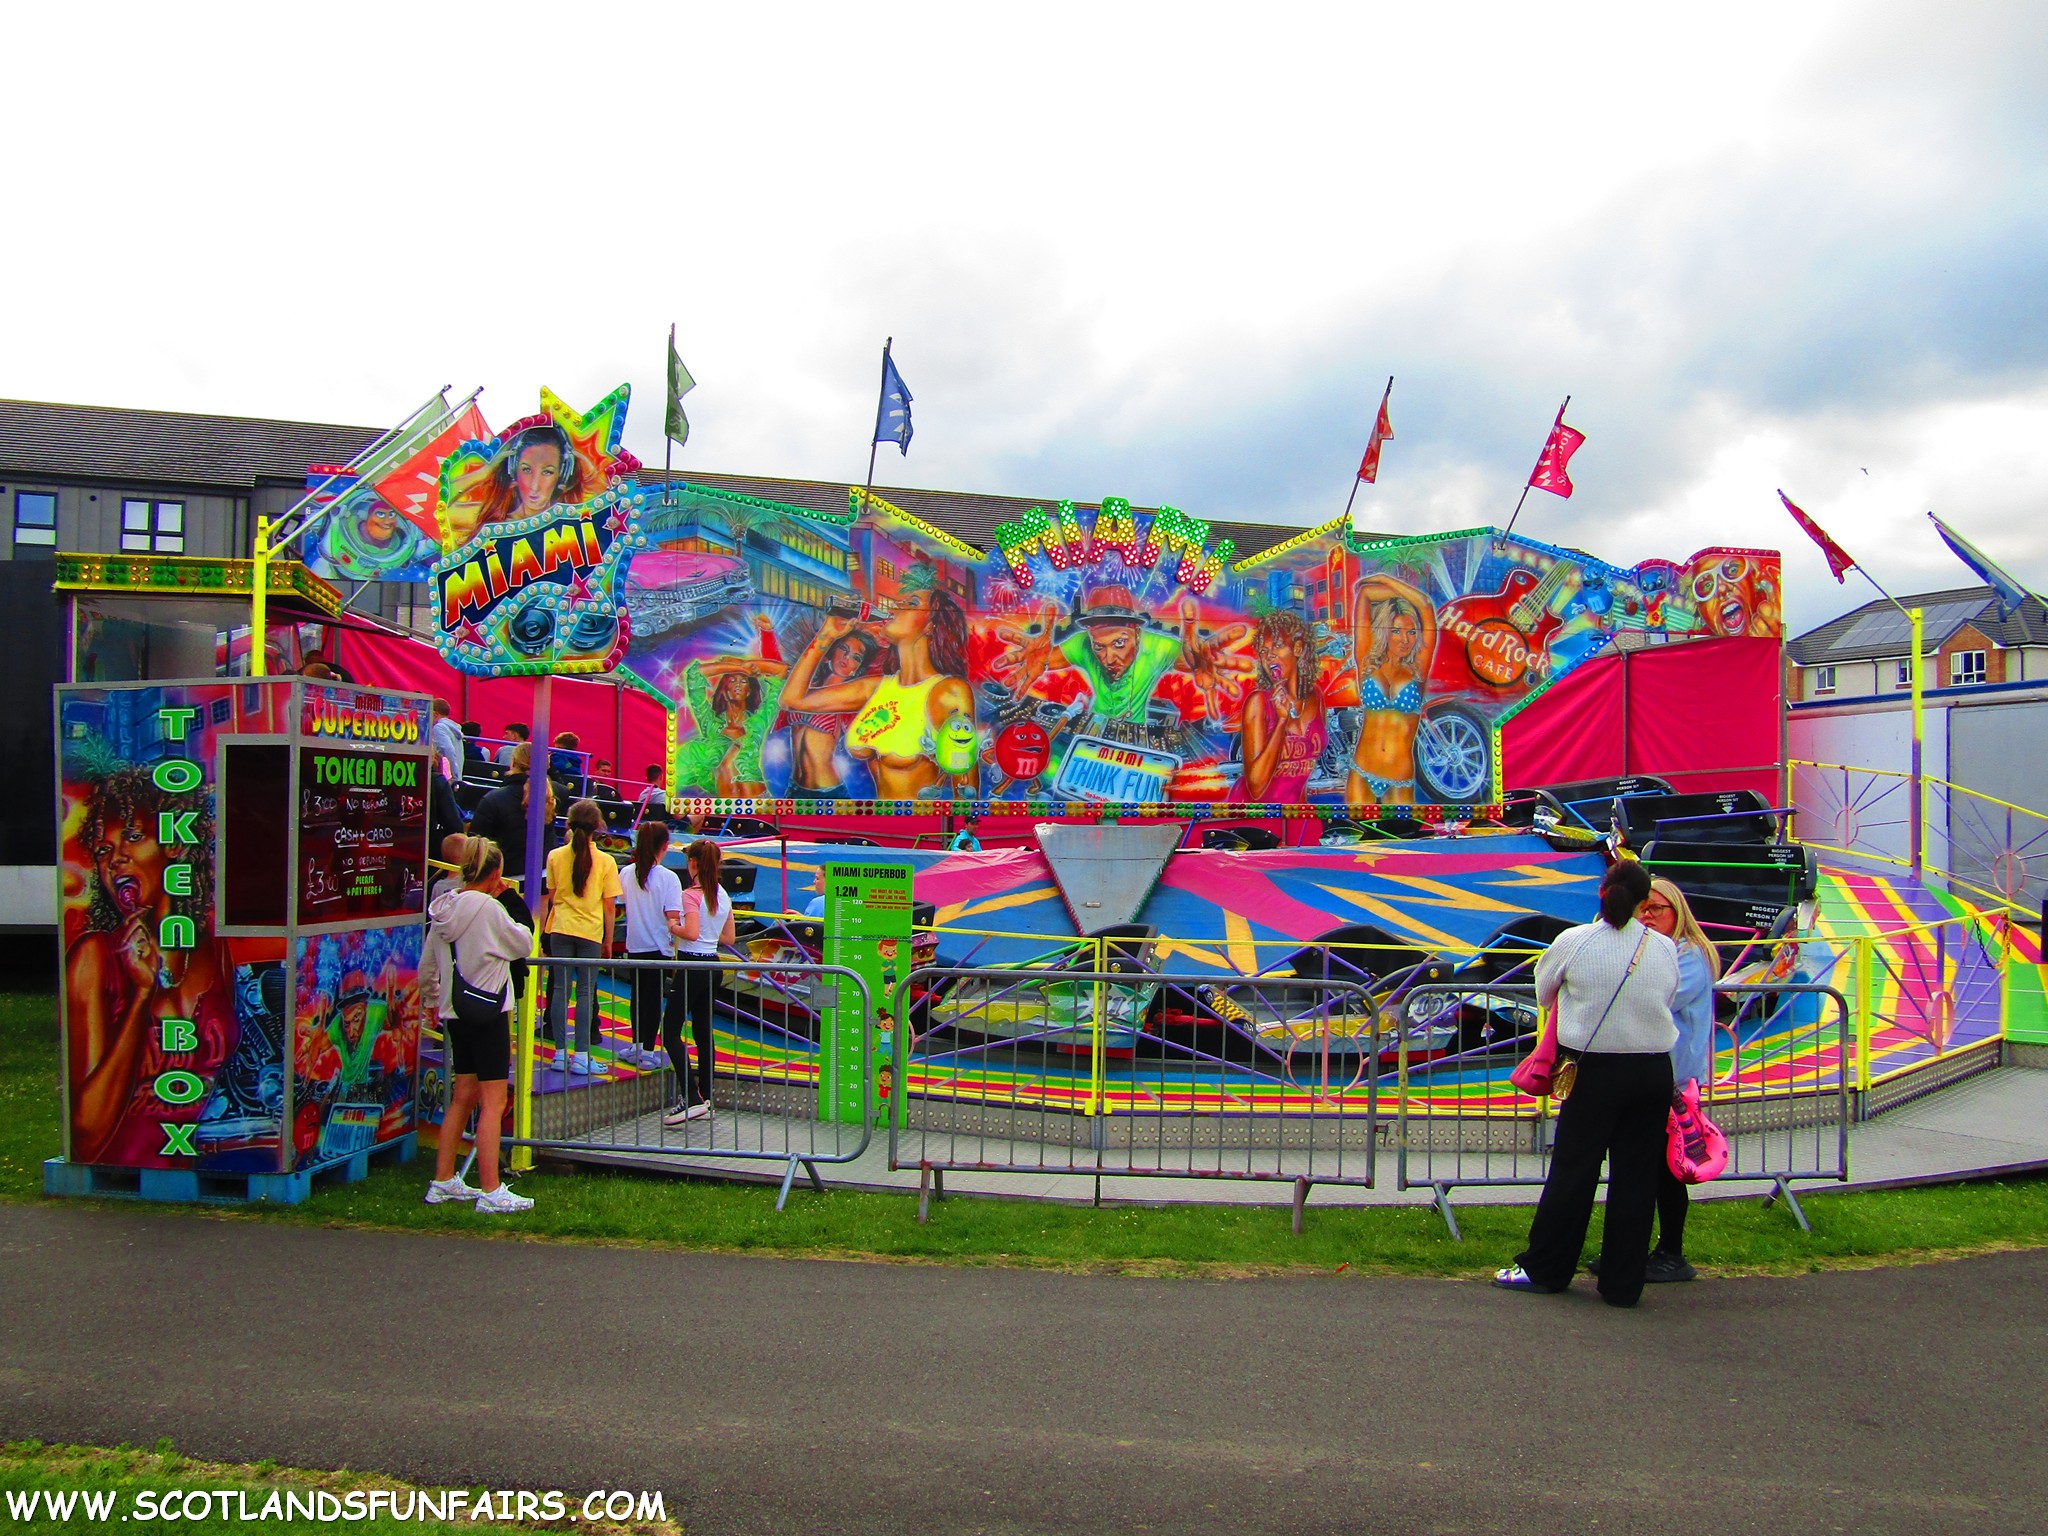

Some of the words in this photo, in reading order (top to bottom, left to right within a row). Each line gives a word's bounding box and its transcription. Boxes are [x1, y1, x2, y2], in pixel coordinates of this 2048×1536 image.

[994, 496, 1236, 594] MIAMI
[1437, 605, 1497, 650] Hard
[1498, 632, 1551, 679] Rock
[1473, 655, 1515, 680] CAFE
[312, 696, 419, 743] SUPERBOB
[1097, 746, 1145, 767] MIAMI
[313, 756, 377, 785] TOKEN
[382, 760, 416, 787] BOX
[1065, 756, 1122, 796] THINK
[1120, 769, 1169, 803] FUN
[152, 708, 202, 949] TOKEN
[334, 826, 359, 844] CASH
[355, 875, 375, 885] PLEASE
[832, 866, 861, 878] MIAMI
[862, 867, 907, 880] SUPERBOB
[351, 887, 362, 897] PAY
[363, 886, 379, 895] HERE
[834, 885, 858, 898] 1.2M
[1745, 912, 1771, 920] PERSON
[1751, 905, 1779, 913] BIGGEST
[153, 1019, 204, 1157] BOX
